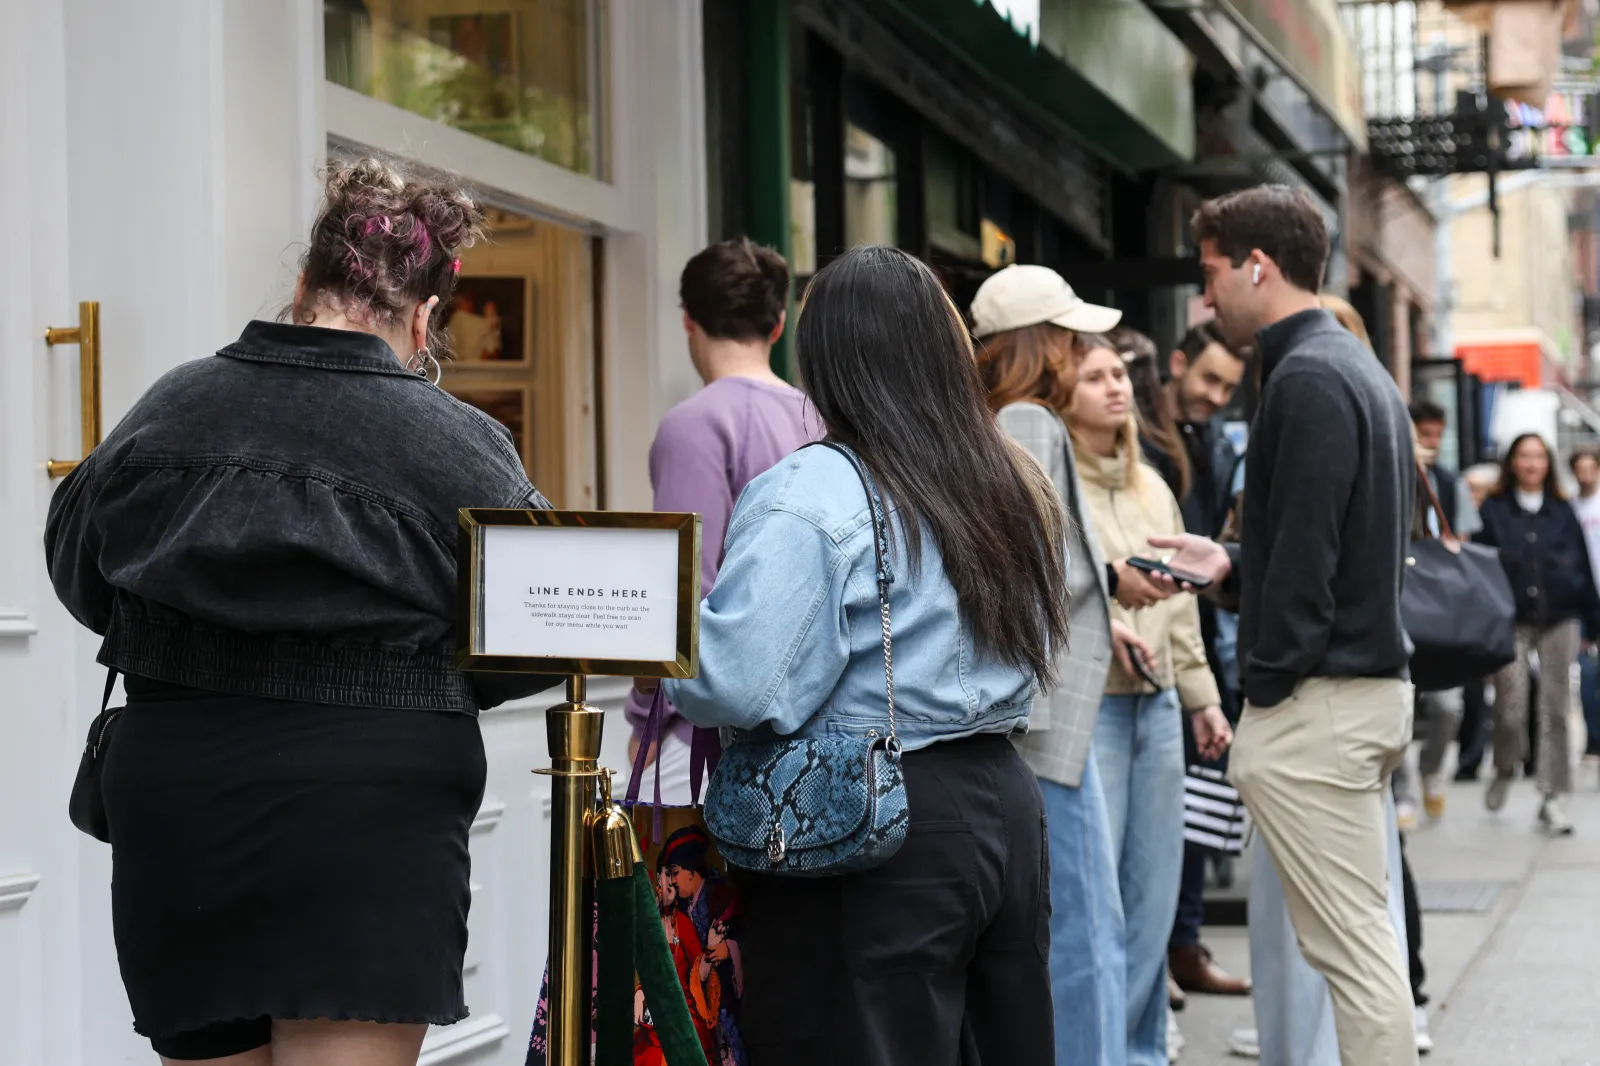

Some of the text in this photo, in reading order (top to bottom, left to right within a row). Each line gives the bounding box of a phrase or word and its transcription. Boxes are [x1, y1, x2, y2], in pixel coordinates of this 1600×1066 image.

[529, 587, 648, 598] LINE ENDS HERE
[557, 603, 579, 611] staying
[558, 612, 574, 620] stays
